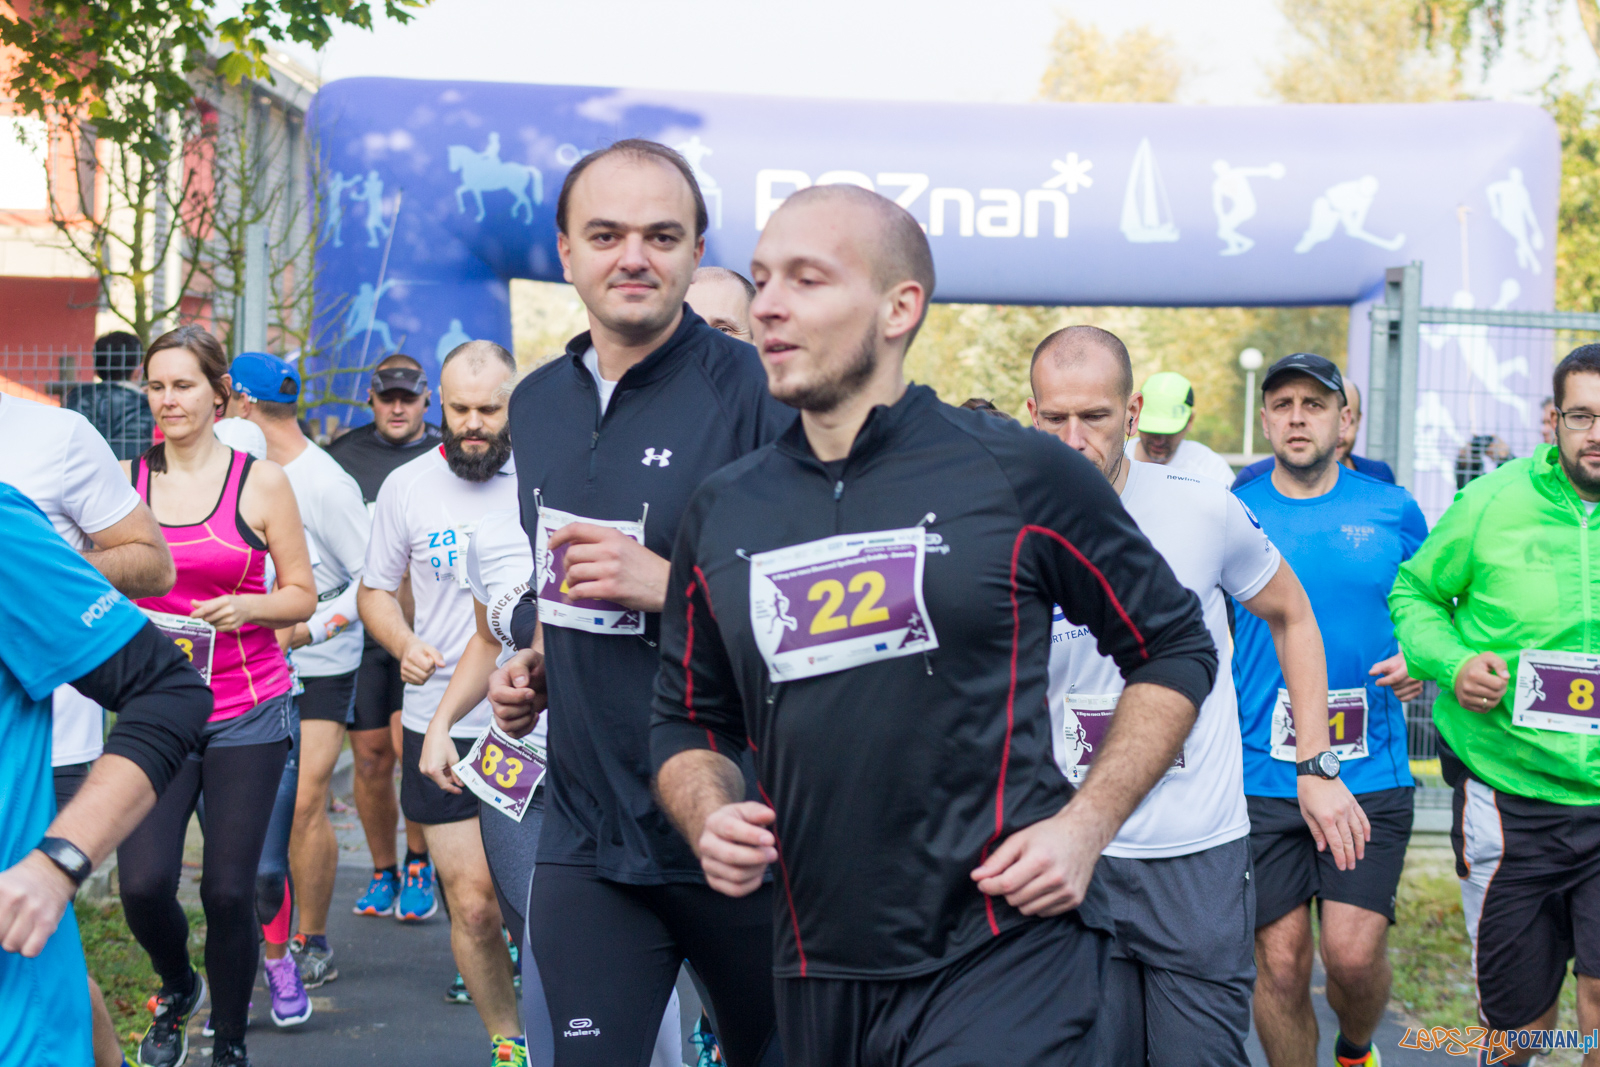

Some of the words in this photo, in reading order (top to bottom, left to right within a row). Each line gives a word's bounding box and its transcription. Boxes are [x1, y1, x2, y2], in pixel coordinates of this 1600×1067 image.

[807, 570, 890, 635] 22
[1050, 633, 1063, 644] RT
[1567, 678, 1595, 711] 8
[481, 743, 524, 789] 83
[563, 1028, 601, 1038] Kalenji
